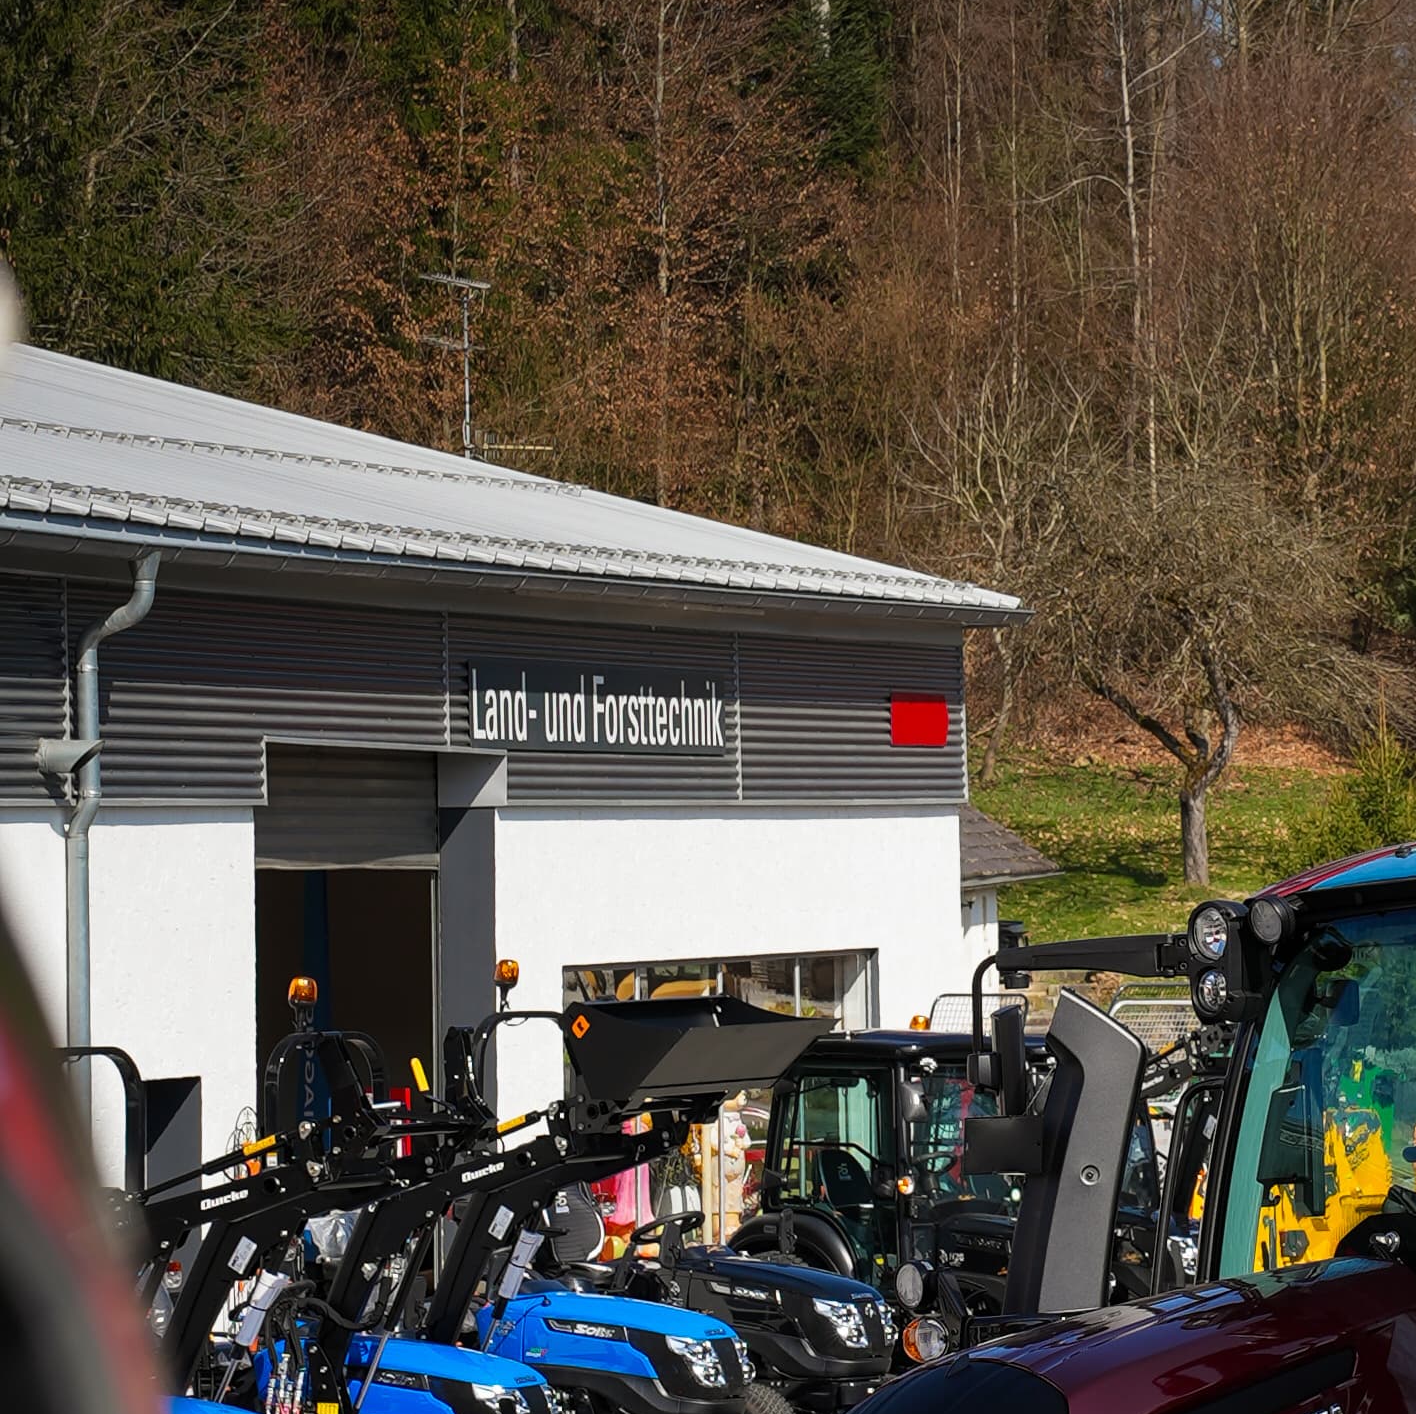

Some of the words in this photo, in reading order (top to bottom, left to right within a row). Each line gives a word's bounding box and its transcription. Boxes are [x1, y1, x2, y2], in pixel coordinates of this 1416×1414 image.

[471, 667, 537, 742] Land-
[544, 673, 586, 744] und
[592, 674, 725, 747] Forsttechnik
[460, 1161, 505, 1183] Quicke
[200, 1189, 249, 1211] Quicke
